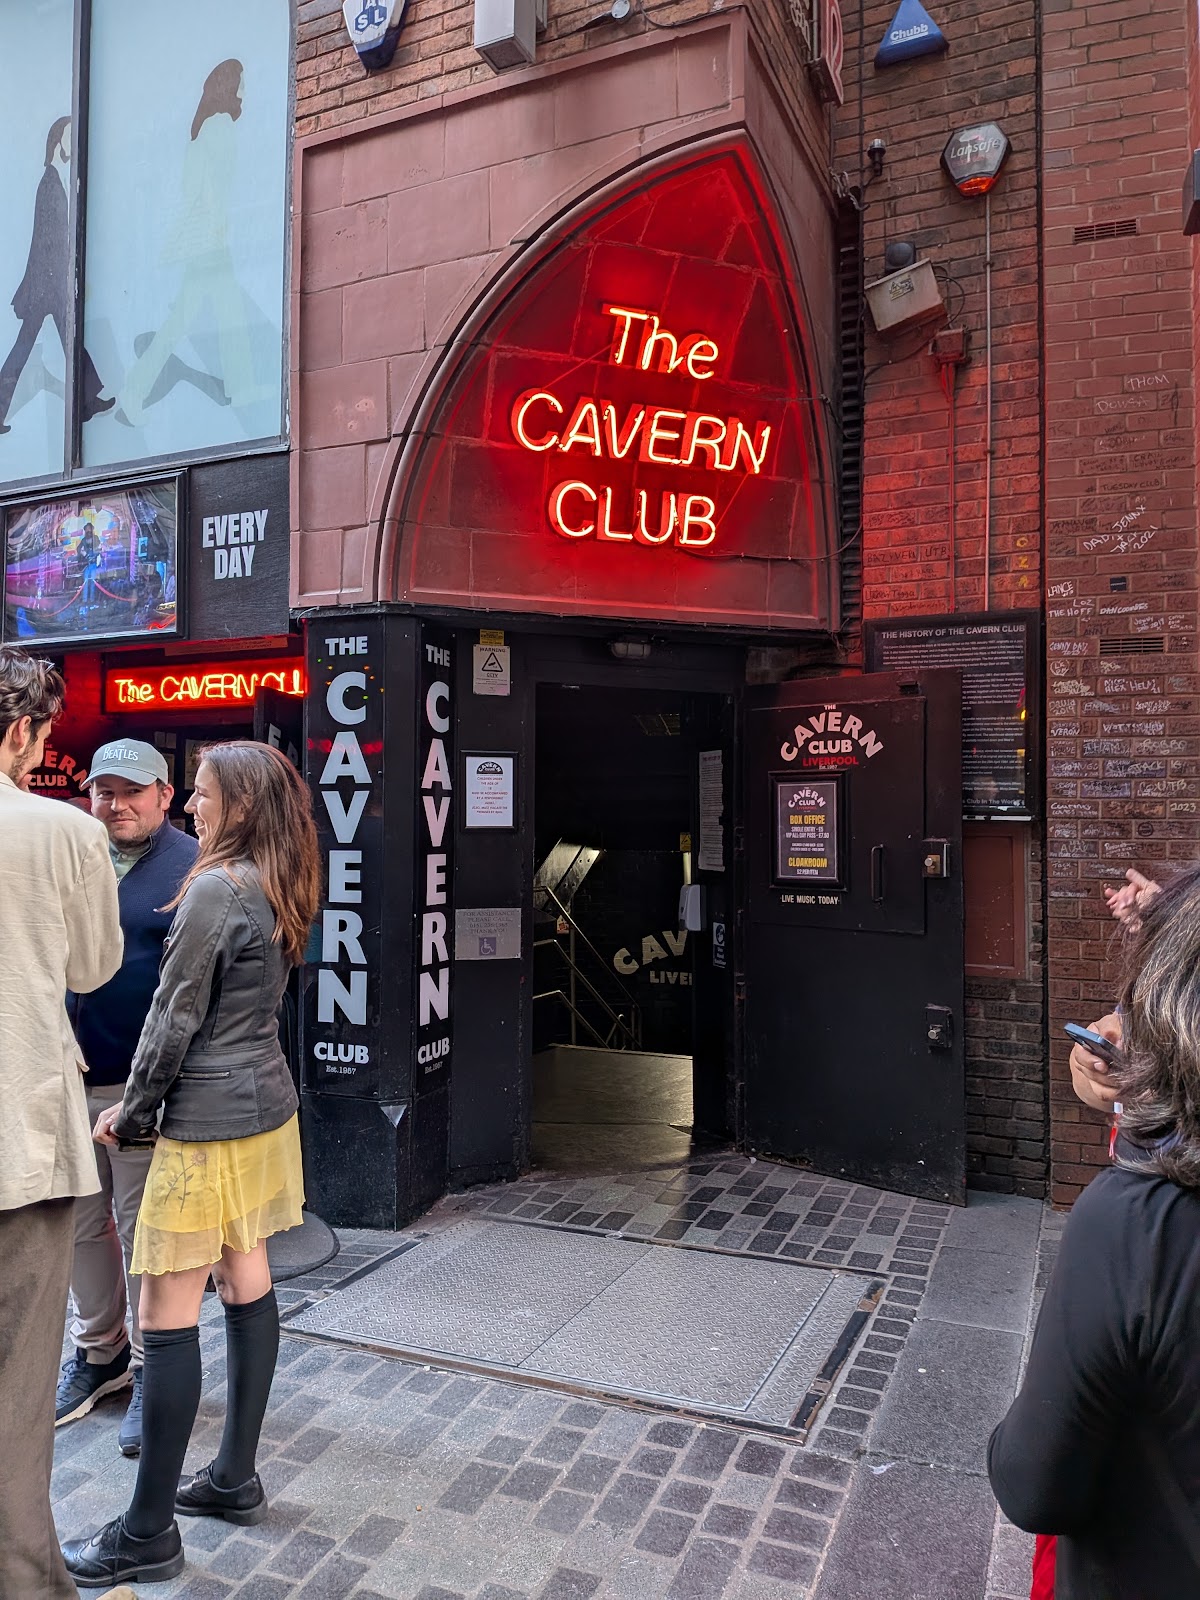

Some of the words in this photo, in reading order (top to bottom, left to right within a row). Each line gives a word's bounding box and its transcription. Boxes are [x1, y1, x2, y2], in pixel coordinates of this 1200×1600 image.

[889, 23, 929, 40] Chubb
[950, 137, 1002, 159] Lansafe
[603, 303, 719, 379] The
[1126, 374, 1170, 391] THOM
[511, 388, 771, 474] CAVERN
[1101, 482, 1138, 491] TUESDAY
[549, 480, 716, 548] CLUB
[202, 508, 269, 548] EVERY
[1133, 525, 1158, 549] 2021
[214, 545, 256, 580] DAY
[1047, 581, 1074, 597] LANCE
[1048, 610, 1066, 618] THE
[882, 631, 898, 639] THE
[899, 630, 934, 638] HISTORY
[935, 629, 946, 637] OF
[949, 628, 965, 636] THE
[966, 626, 1000, 635] CAVERN
[1002, 625, 1025, 633] CLUB
[325, 636, 368, 656] THE
[426, 643, 451, 667] THE
[114, 679, 155, 703] The
[160, 673, 259, 701] CAVERN
[781, 711, 884, 762] CAVERN
[102, 746, 139, 761] BEATLES
[808, 740, 853, 755] CLUB
[803, 756, 859, 767] LIVERPOOL
[788, 790, 826, 808] CAVERN
[1170, 802, 1197, 812] 2023
[790, 815, 803, 824] BOX
[804, 815, 826, 825] OFFICE
[319, 671, 372, 1026] CAVERN
[420, 680, 452, 1026] CAVERN
[788, 857, 828, 868] CLOAKROOM
[781, 895, 795, 903] LIVE
[796, 895, 816, 904] MUSIC
[817, 896, 839, 905] TODAY
[613, 930, 688, 975] CAV
[314, 1041, 370, 1064] CLUB
[418, 1037, 450, 1064] CLUB
